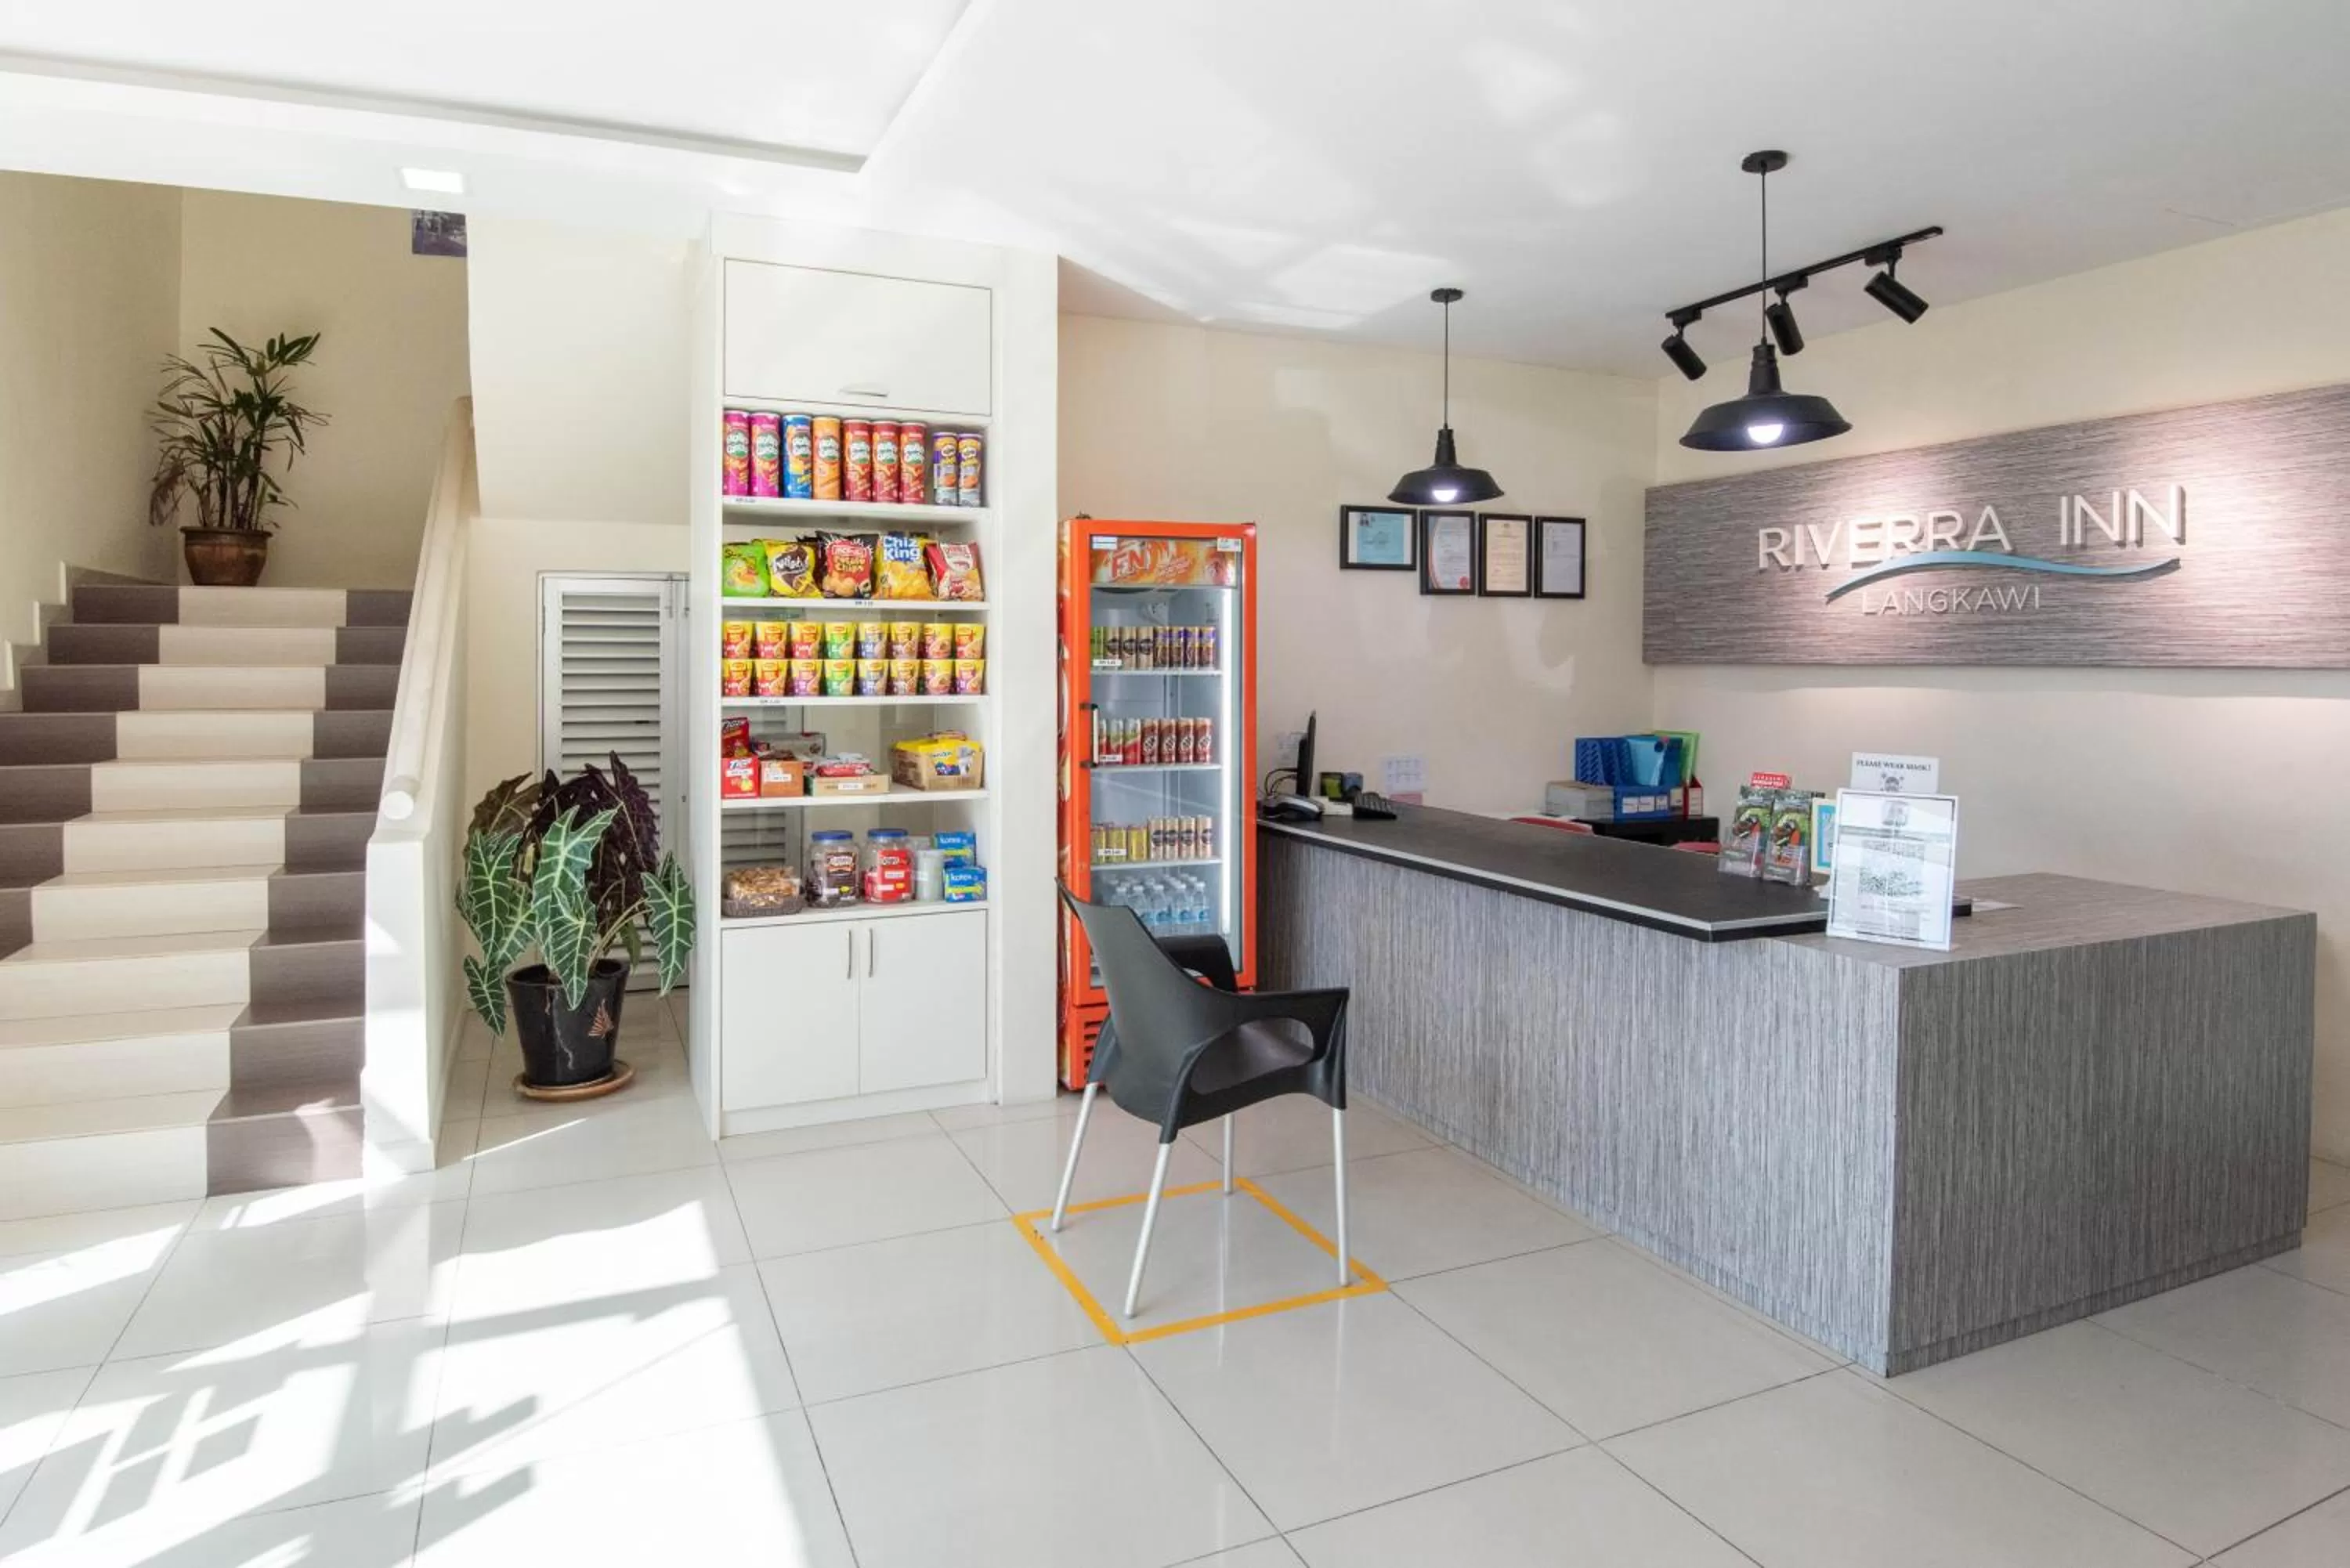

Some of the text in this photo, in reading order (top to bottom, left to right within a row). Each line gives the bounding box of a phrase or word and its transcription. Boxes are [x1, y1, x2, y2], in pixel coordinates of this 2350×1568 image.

[1758, 484, 2186, 573] RIVERRA INN
[1860, 586, 2040, 615] LANGKAWI
